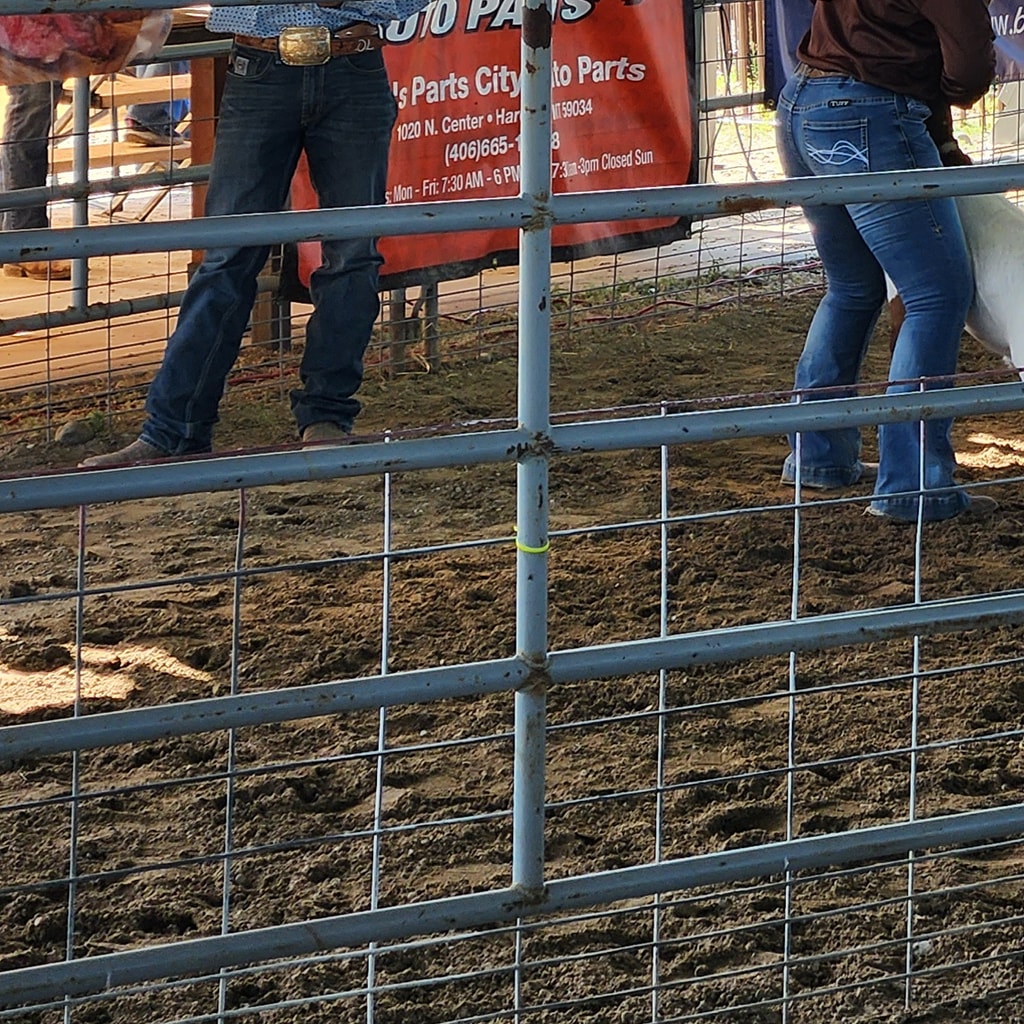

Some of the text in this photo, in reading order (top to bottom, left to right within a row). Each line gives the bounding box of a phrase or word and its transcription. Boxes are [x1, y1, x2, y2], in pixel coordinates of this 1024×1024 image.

[411, 73, 470, 106] Parts
[475, 65, 522, 98] City
[577, 56, 647, 84] Parts
[397, 120, 421, 142] 1020
[424, 118, 439, 137] N.
[442, 114, 484, 135] Center
[562, 98, 593, 119] 59034
[394, 184, 413, 203] Mon
[422, 178, 440, 198] Fri:
[442, 174, 463, 194] 7:30
[465, 170, 485, 190] AM
[493, 169, 502, 186] 6
[601, 150, 633, 171] Closed
[634, 148, 654, 166] Sun
